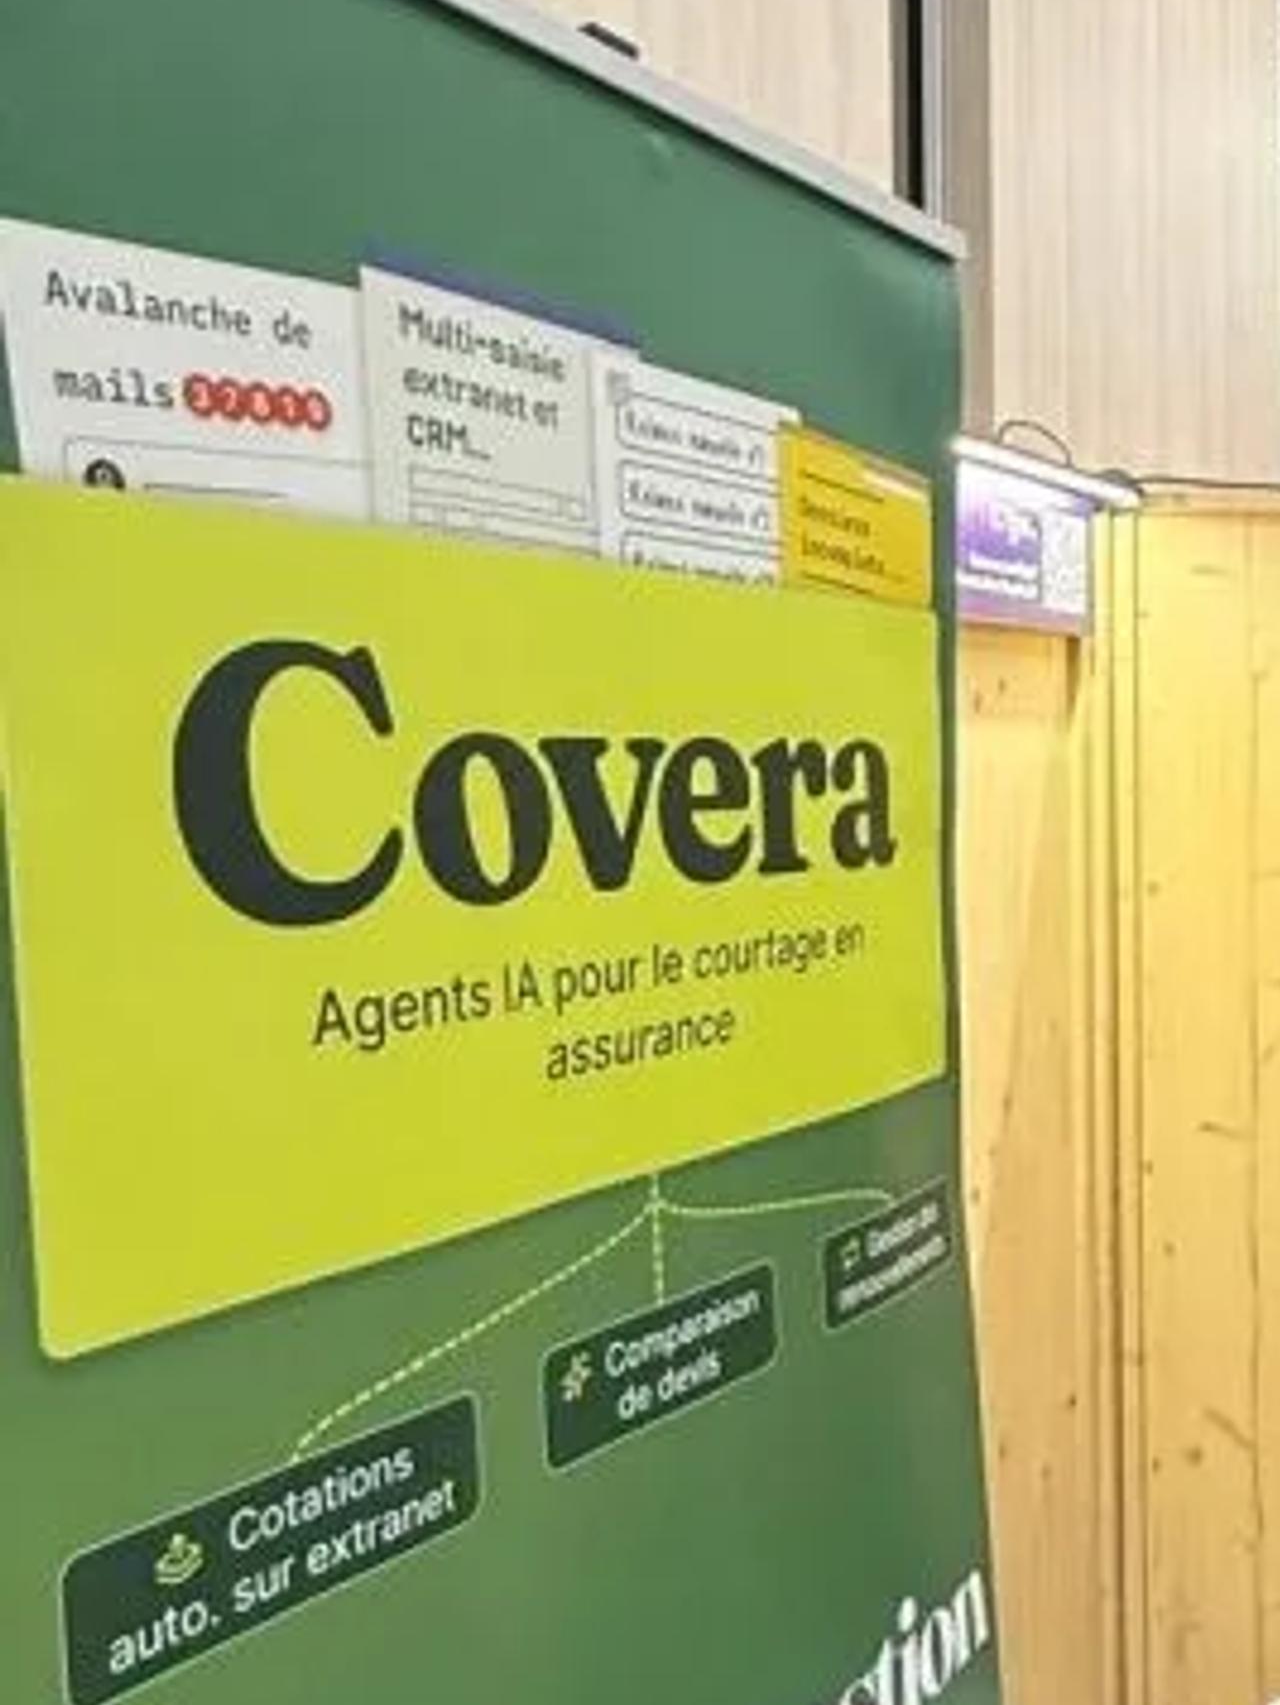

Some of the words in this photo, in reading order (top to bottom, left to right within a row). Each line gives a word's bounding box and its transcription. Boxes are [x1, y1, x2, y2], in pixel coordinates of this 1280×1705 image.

[45, 270, 252, 337] Avalanche
[273, 309, 312, 348] de
[399, 302, 565, 384] Multi-saisie
[54, 367, 175, 408] mails
[403, 367, 529, 422] extranet
[172, 637, 896, 928] Covera
[312, 975, 493, 1054] Agents
[502, 960, 544, 1013] IA
[553, 955, 642, 1016] pour
[652, 942, 684, 986] le
[692, 926, 828, 978] courtage
[834, 920, 866, 957] en
[545, 1008, 737, 1081] assurance
[604, 1290, 760, 1378] Comparaison
[617, 1383, 653, 1420] de
[657, 1347, 722, 1401] devis
[229, 1446, 416, 1551] Cotations
[108, 1600, 222, 1675] auto.
[233, 1554, 296, 1613] sur
[305, 1479, 458, 1575] extranet
